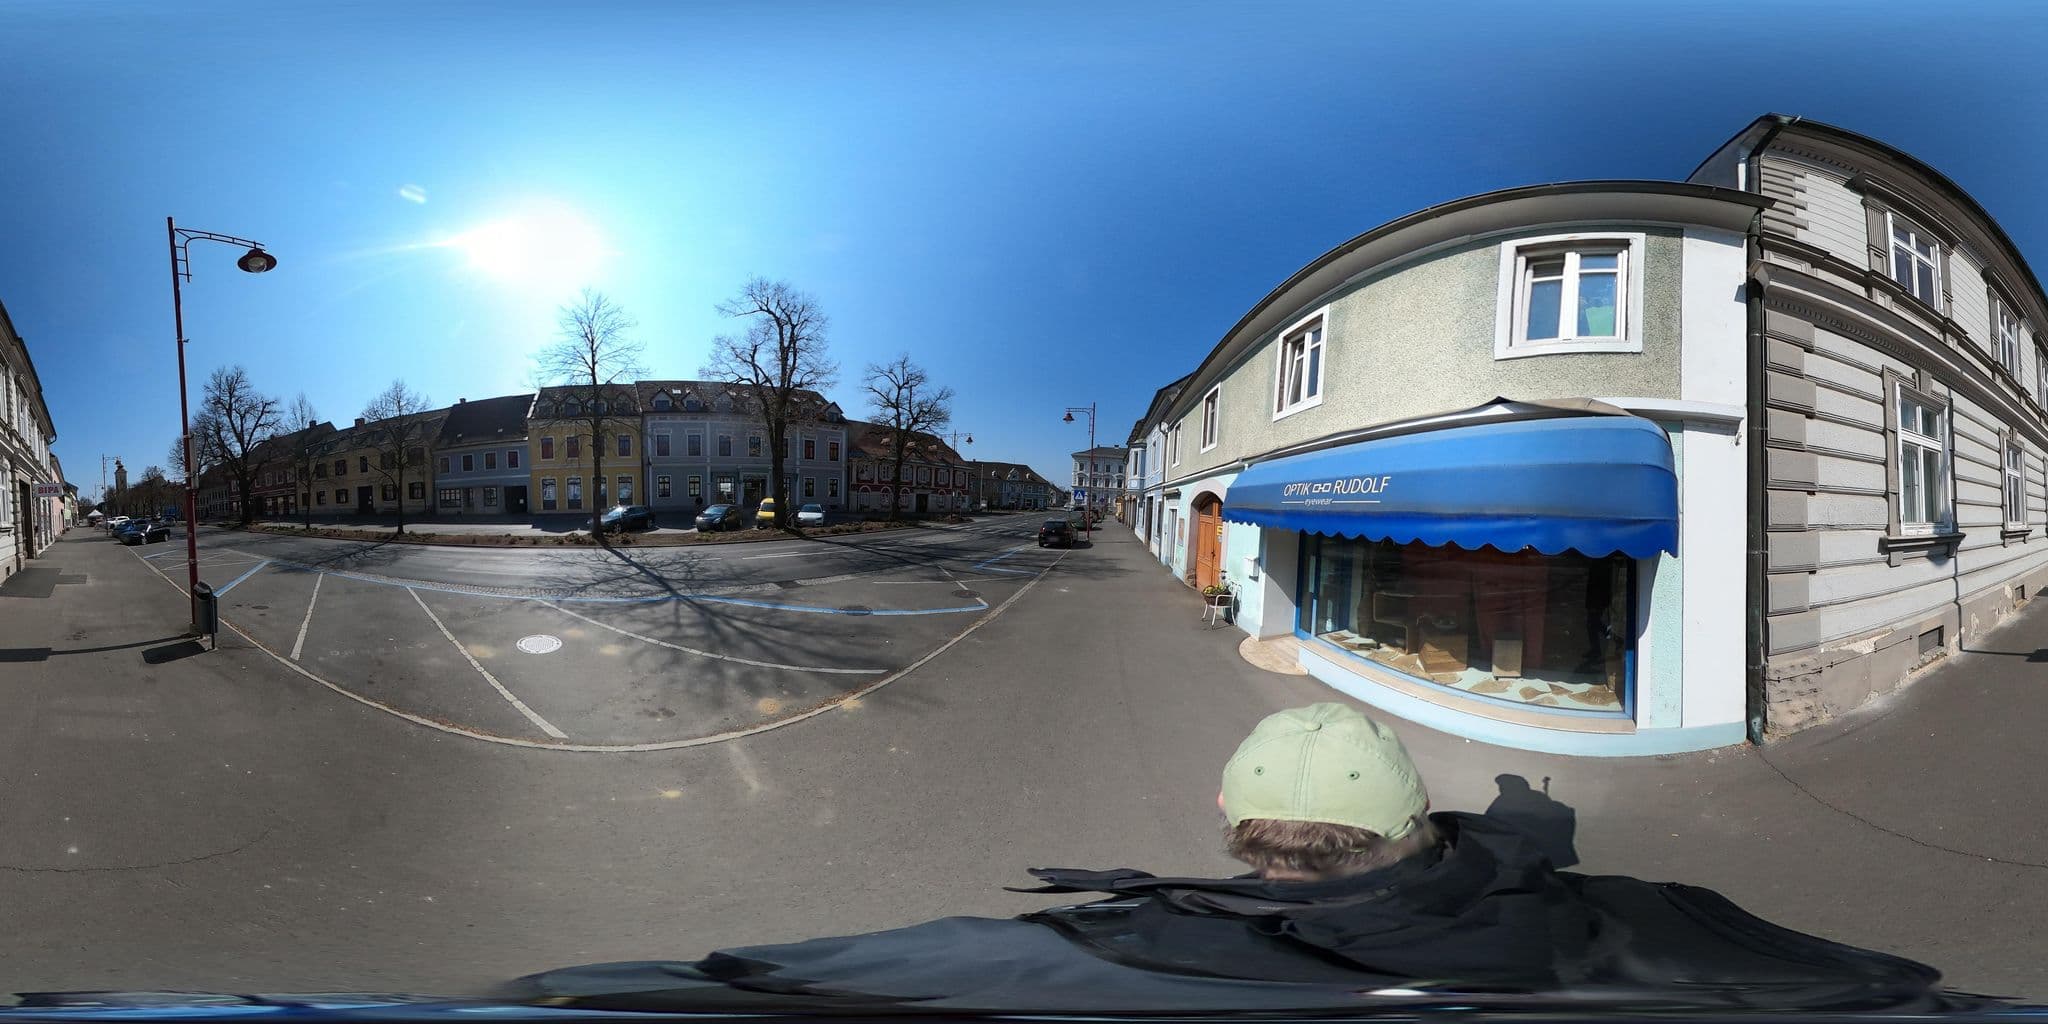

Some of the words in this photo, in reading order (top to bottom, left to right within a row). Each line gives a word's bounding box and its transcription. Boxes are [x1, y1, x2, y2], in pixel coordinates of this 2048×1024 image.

[37, 486, 59, 494] BIPA
[1284, 484, 1311, 497] OPTIK
[1333, 477, 1391, 494] RUDOLF
[1304, 498, 1332, 506] eyewear
